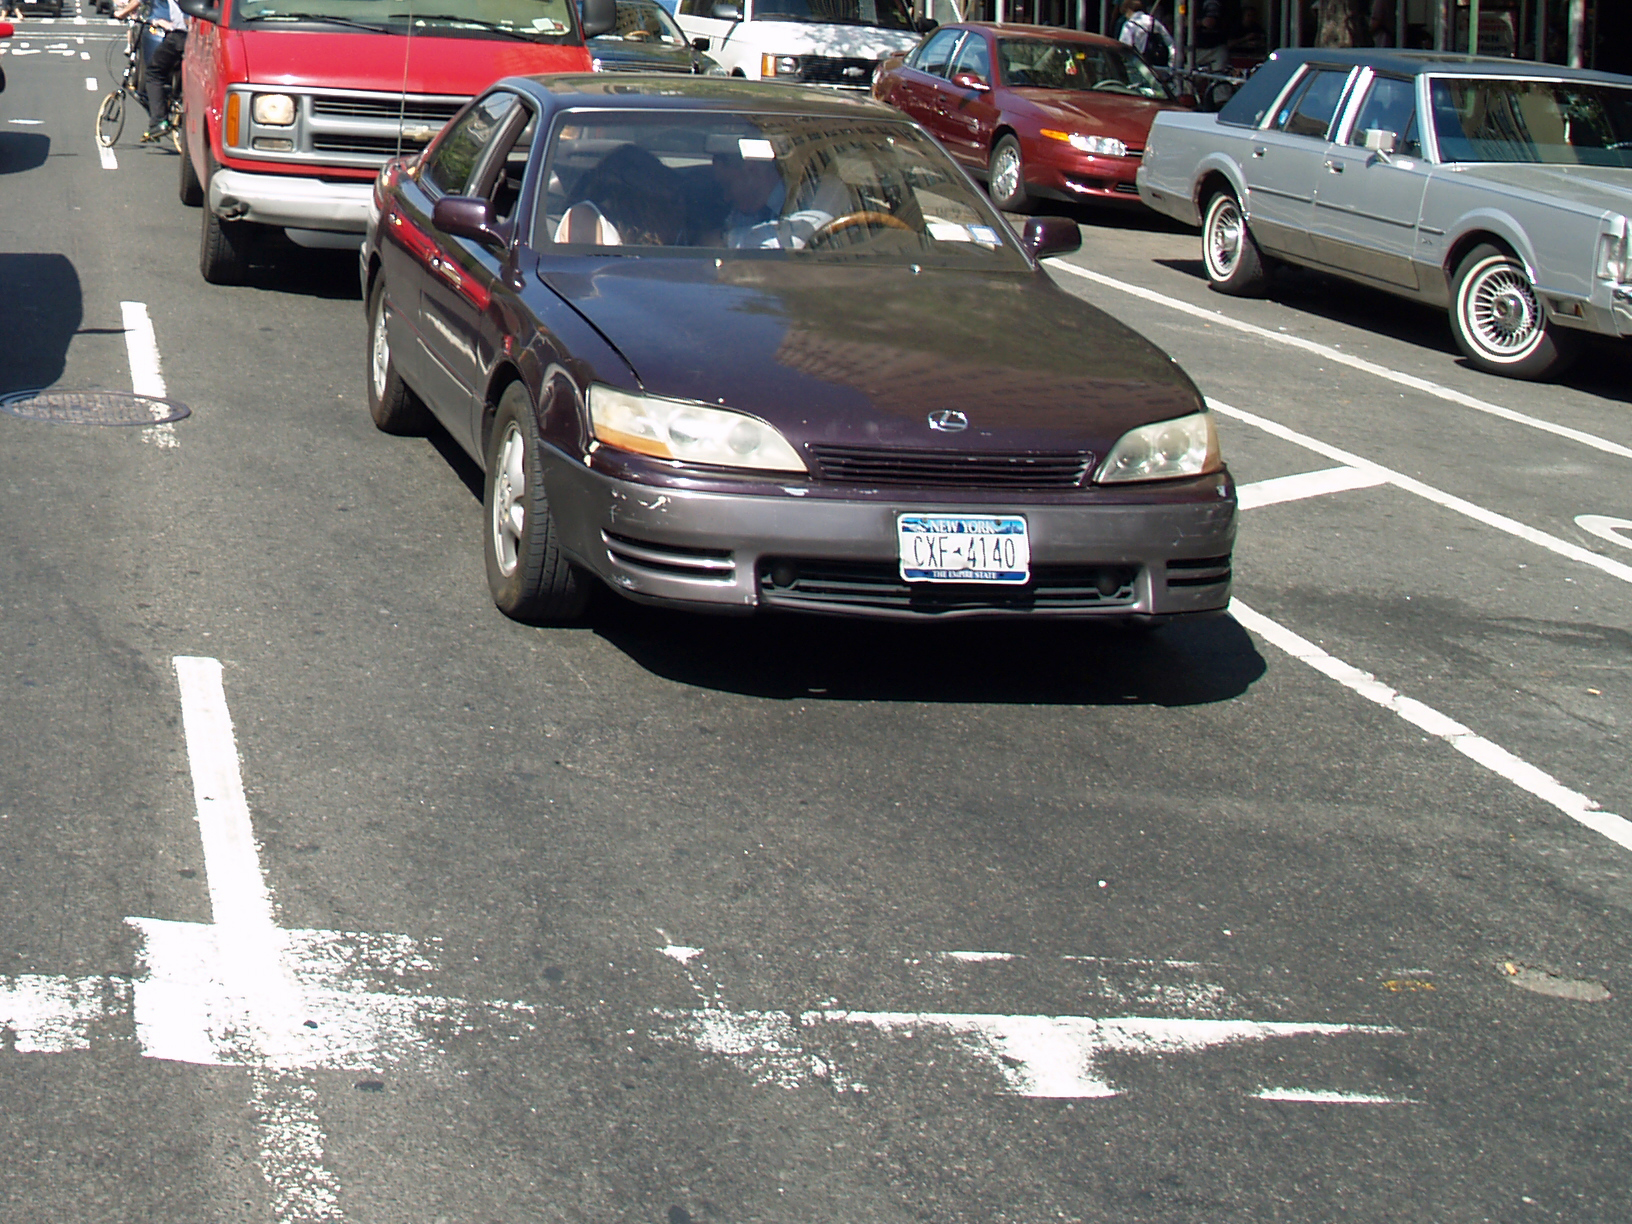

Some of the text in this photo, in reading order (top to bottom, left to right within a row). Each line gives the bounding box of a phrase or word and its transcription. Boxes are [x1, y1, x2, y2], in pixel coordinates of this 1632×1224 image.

[930, 520, 996, 534] NEW YORK
[932, 570, 997, 580] THE EMPIRE STATE
